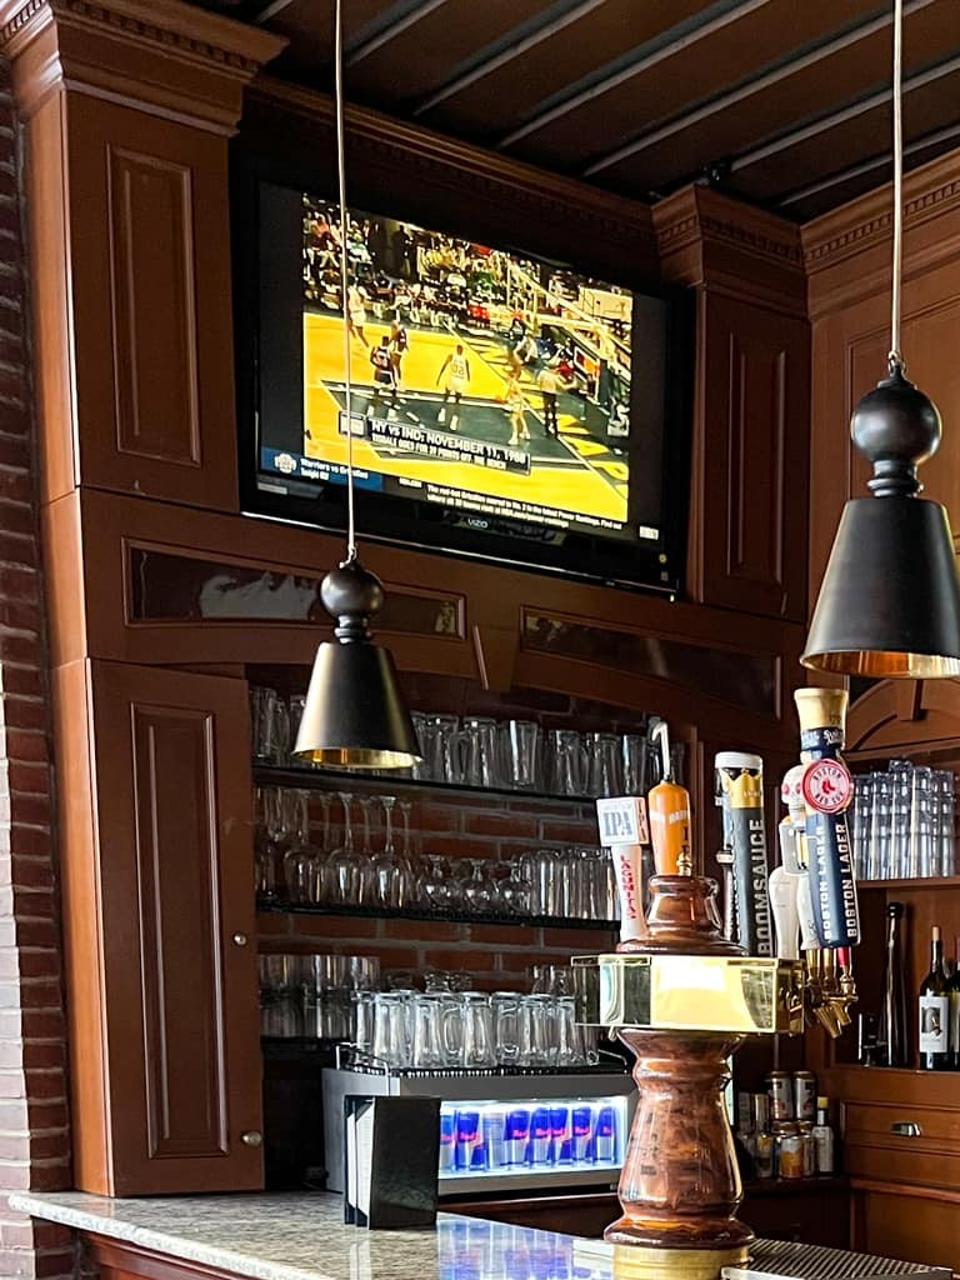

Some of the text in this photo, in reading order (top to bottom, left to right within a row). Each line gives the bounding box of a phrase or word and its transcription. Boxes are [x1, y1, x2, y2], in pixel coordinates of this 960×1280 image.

[426, 431, 484, 454] NOVEMBER
[603, 811, 633, 837] IPA
[749, 819, 771, 956] BOOMSAUCE
[842, 880, 857, 938] BOSTON
